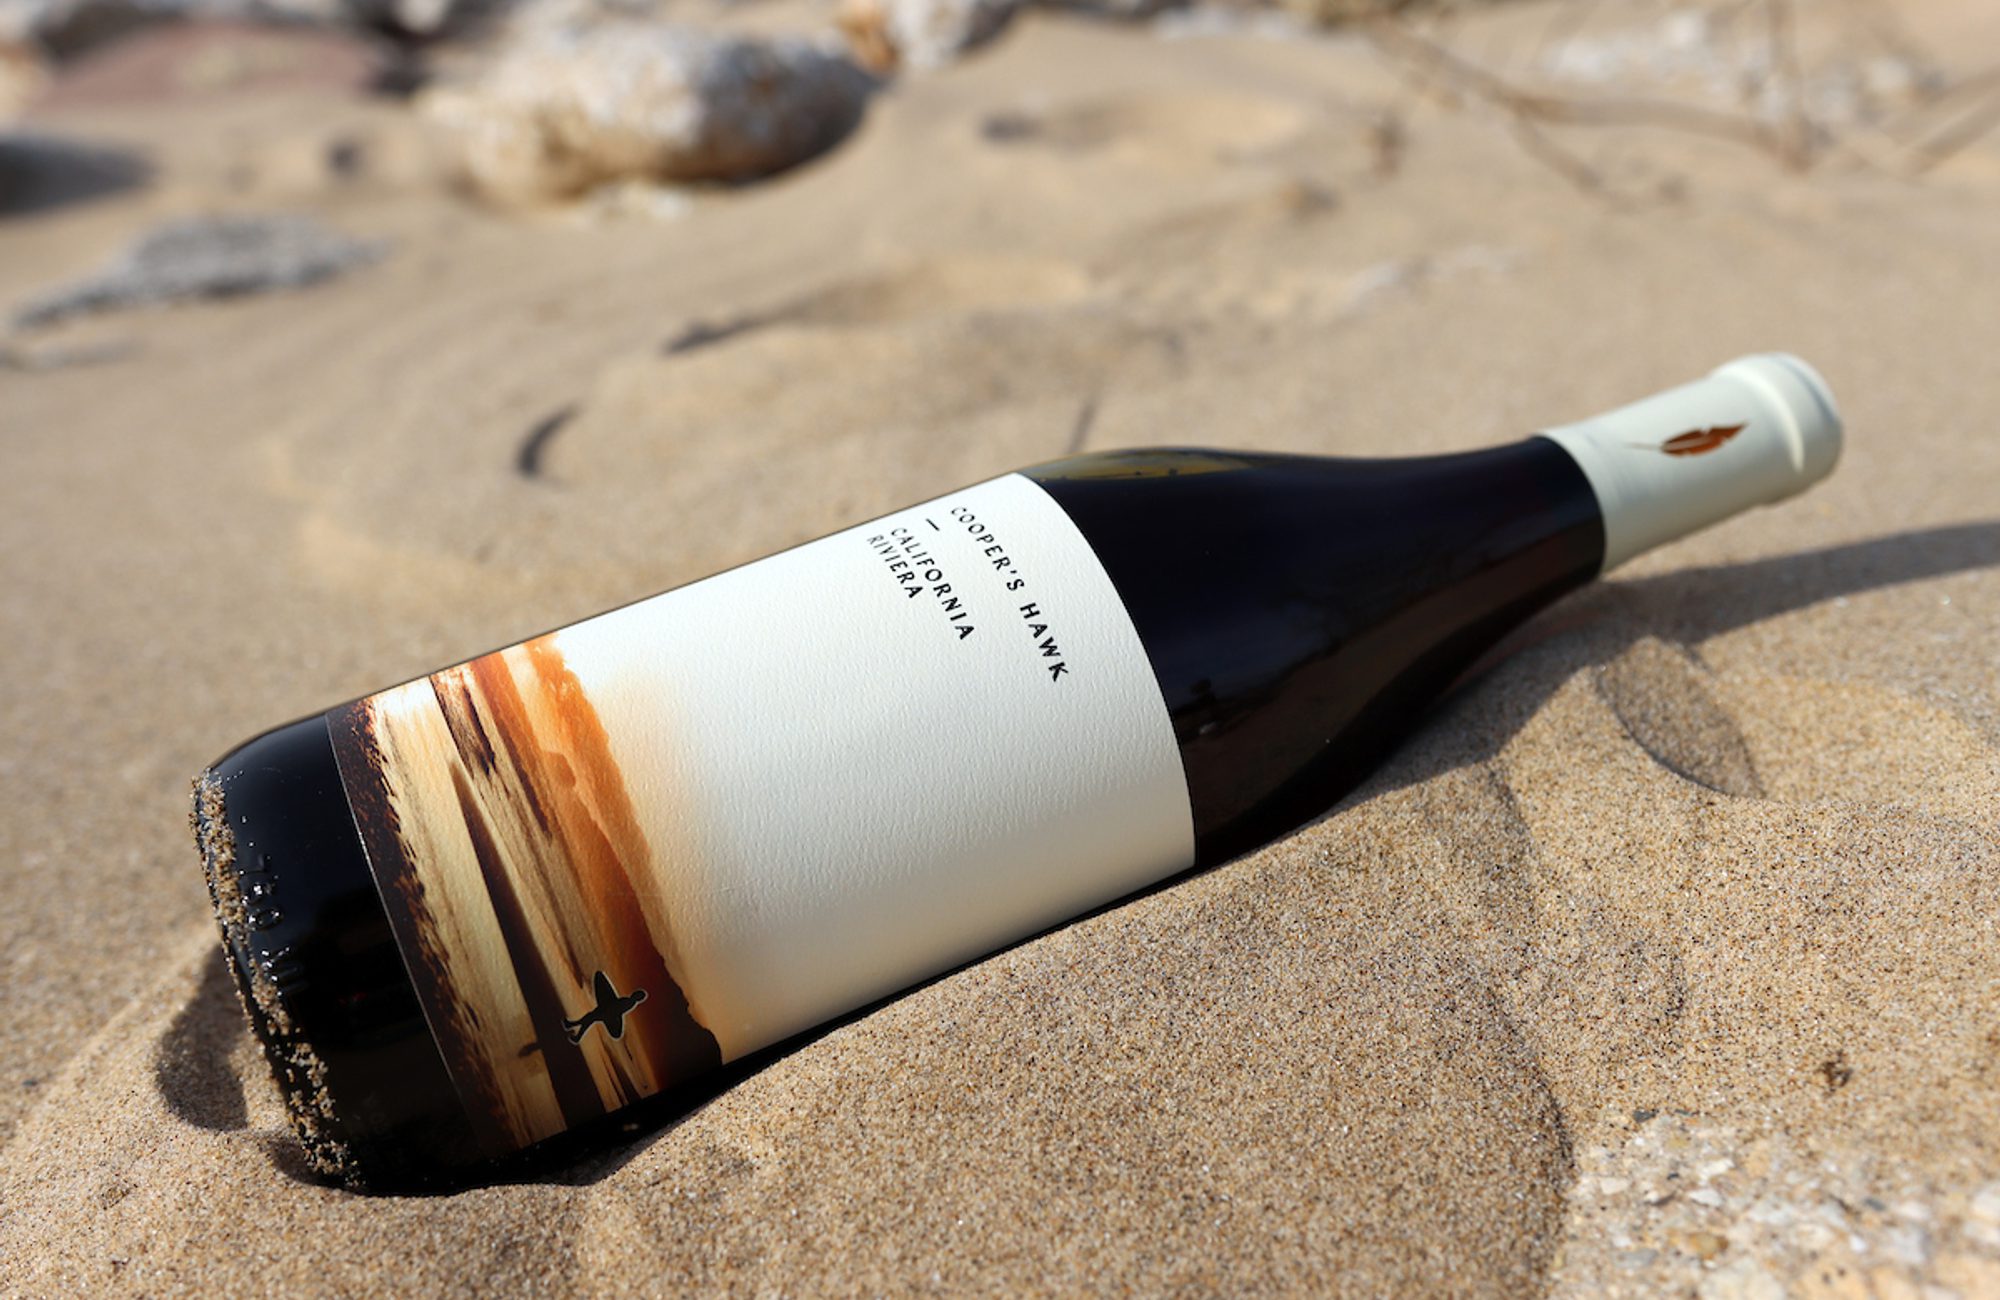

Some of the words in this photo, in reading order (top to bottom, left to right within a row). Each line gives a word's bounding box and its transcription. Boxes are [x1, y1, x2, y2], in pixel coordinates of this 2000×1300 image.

[866, 533, 924, 599] RIVIERA
[890, 526, 975, 640] CALIFORNIA
[950, 505, 1025, 592] COOPER'S
[1019, 602, 1069, 683] HAWK
